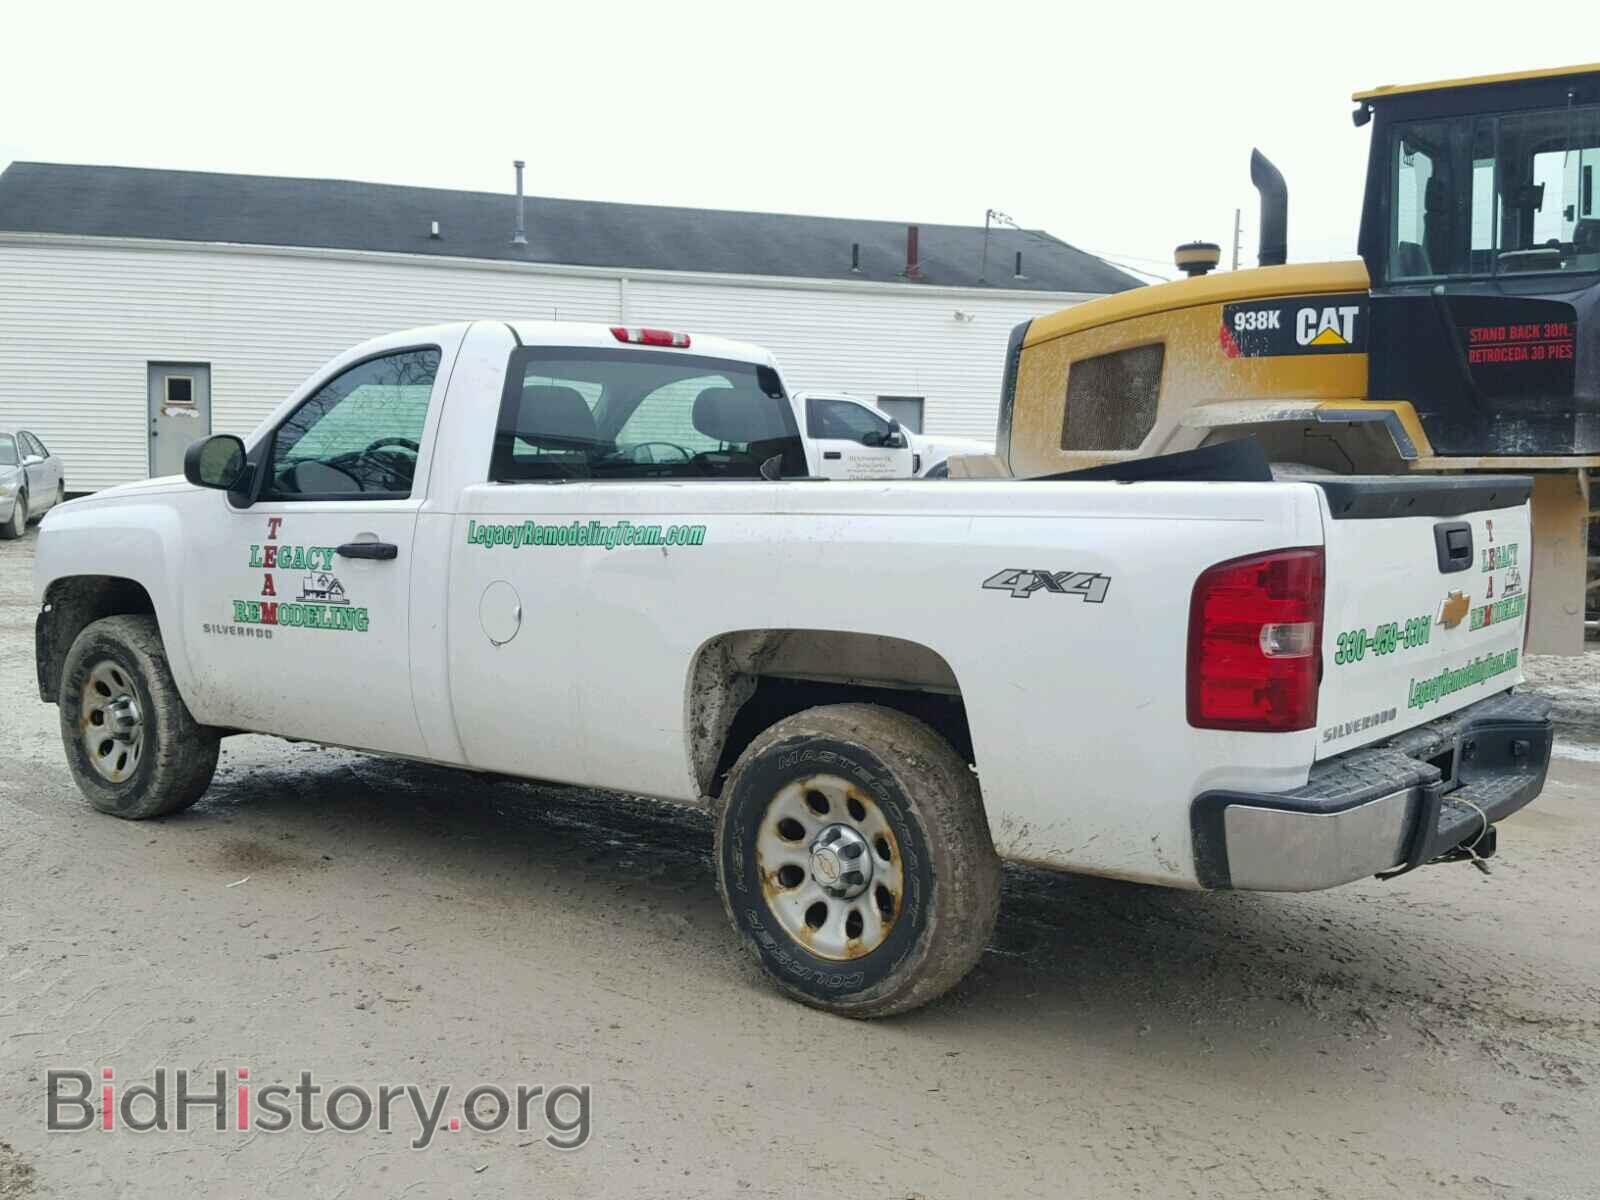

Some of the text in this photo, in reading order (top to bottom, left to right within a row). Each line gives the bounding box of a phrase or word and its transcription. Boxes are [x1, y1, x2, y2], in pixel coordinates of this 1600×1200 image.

[1234, 310, 1281, 331] 938K
[1296, 306, 1359, 346] CAT
[1471, 327, 1505, 342] STAND
[1510, 324, 1540, 339] BACK
[1531, 346, 1545, 360] 30
[1549, 344, 1573, 359] PIES
[468, 520, 706, 550] LegacyRemodelingTeam.com
[249, 545, 337, 571] LEGACY
[233, 600, 369, 632] REMODELING
[203, 623, 273, 639] SILVERADO
[1323, 707, 1397, 744] SILVERADO
